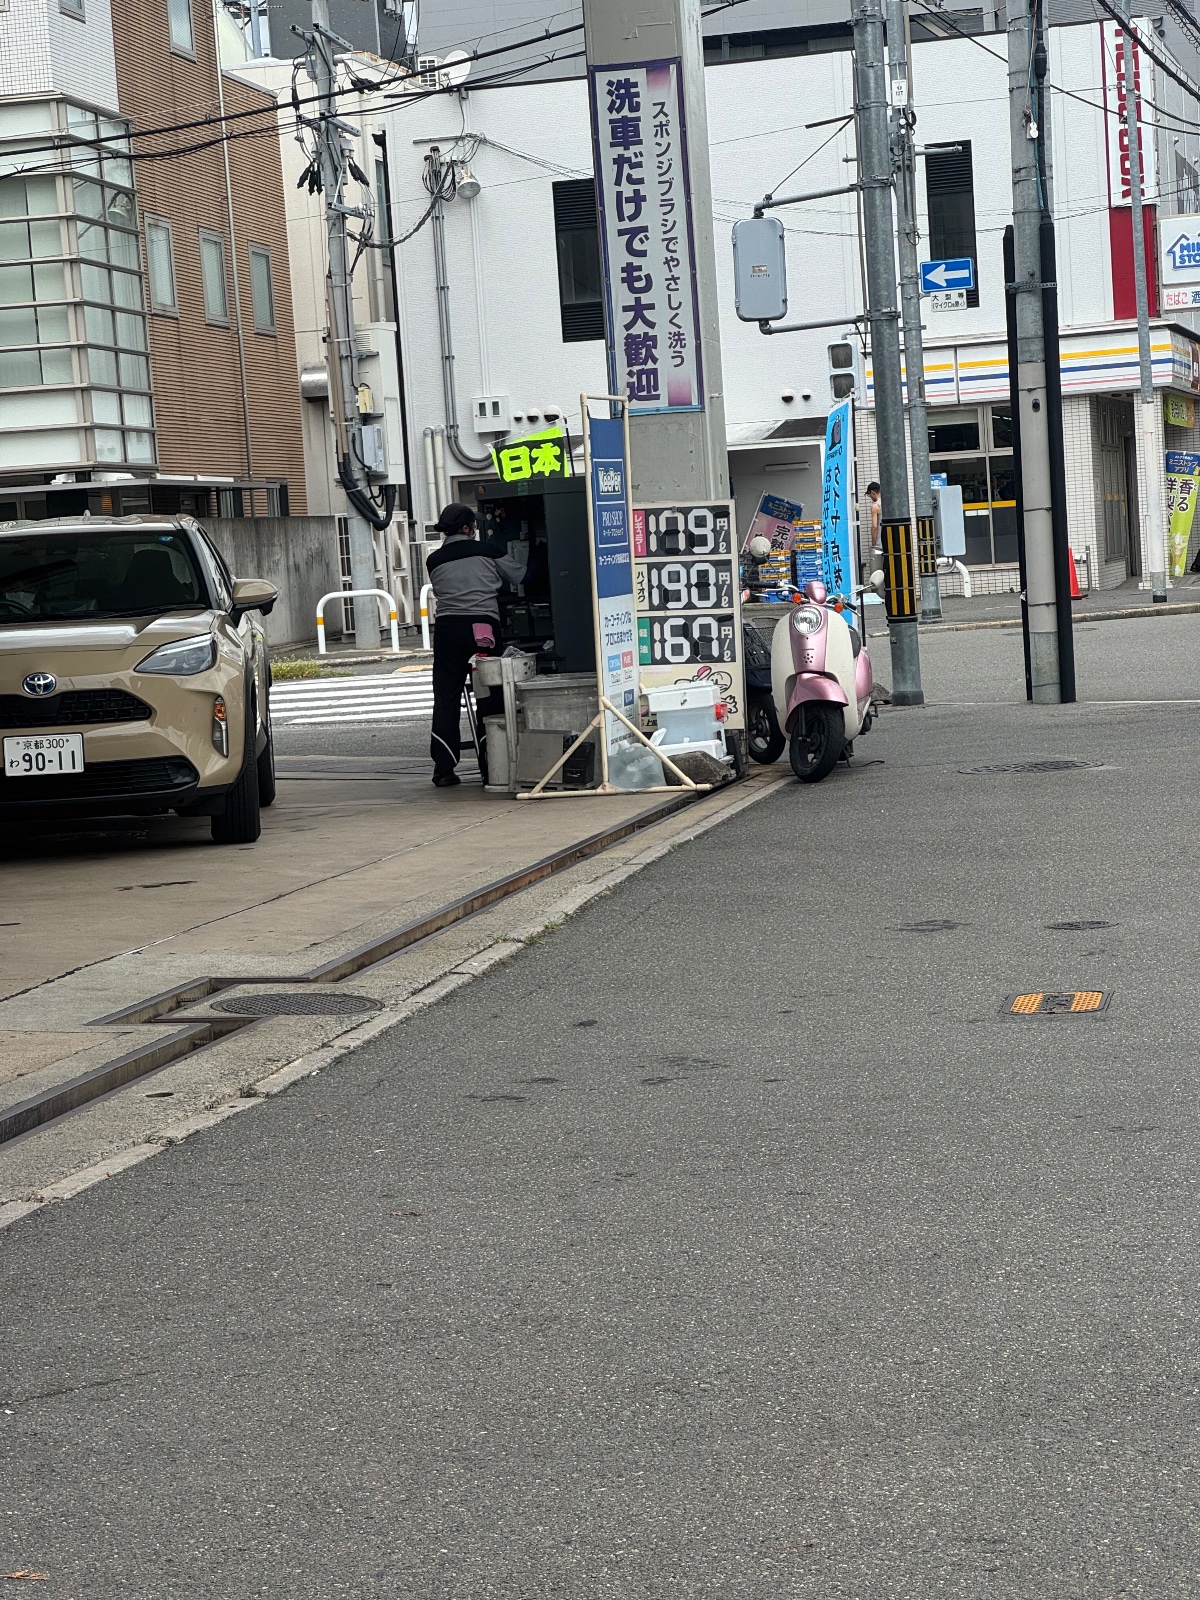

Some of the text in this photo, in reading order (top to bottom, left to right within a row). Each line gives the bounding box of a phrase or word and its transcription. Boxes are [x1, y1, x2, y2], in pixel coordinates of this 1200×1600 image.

[605, 77, 661, 404] 洗車だけでも大歓迎
[652, 101, 687, 368] スポンジブラシでやさしく洗う
[1166, 292, 1189, 306] たばこ
[1168, 458, 1198, 468] ミニストップ
[1174, 466, 1190, 474] アプリ
[598, 467, 622, 495] KeePer
[1177, 479, 1193, 512] 香る
[634, 514, 644, 553] レギュラー
[649, 508, 715, 554] 179
[636, 571, 647, 603] ハイオク
[651, 562, 717, 609] 190
[653, 616, 720, 663] 167
[9, 750, 76, 772] わ 90-11
